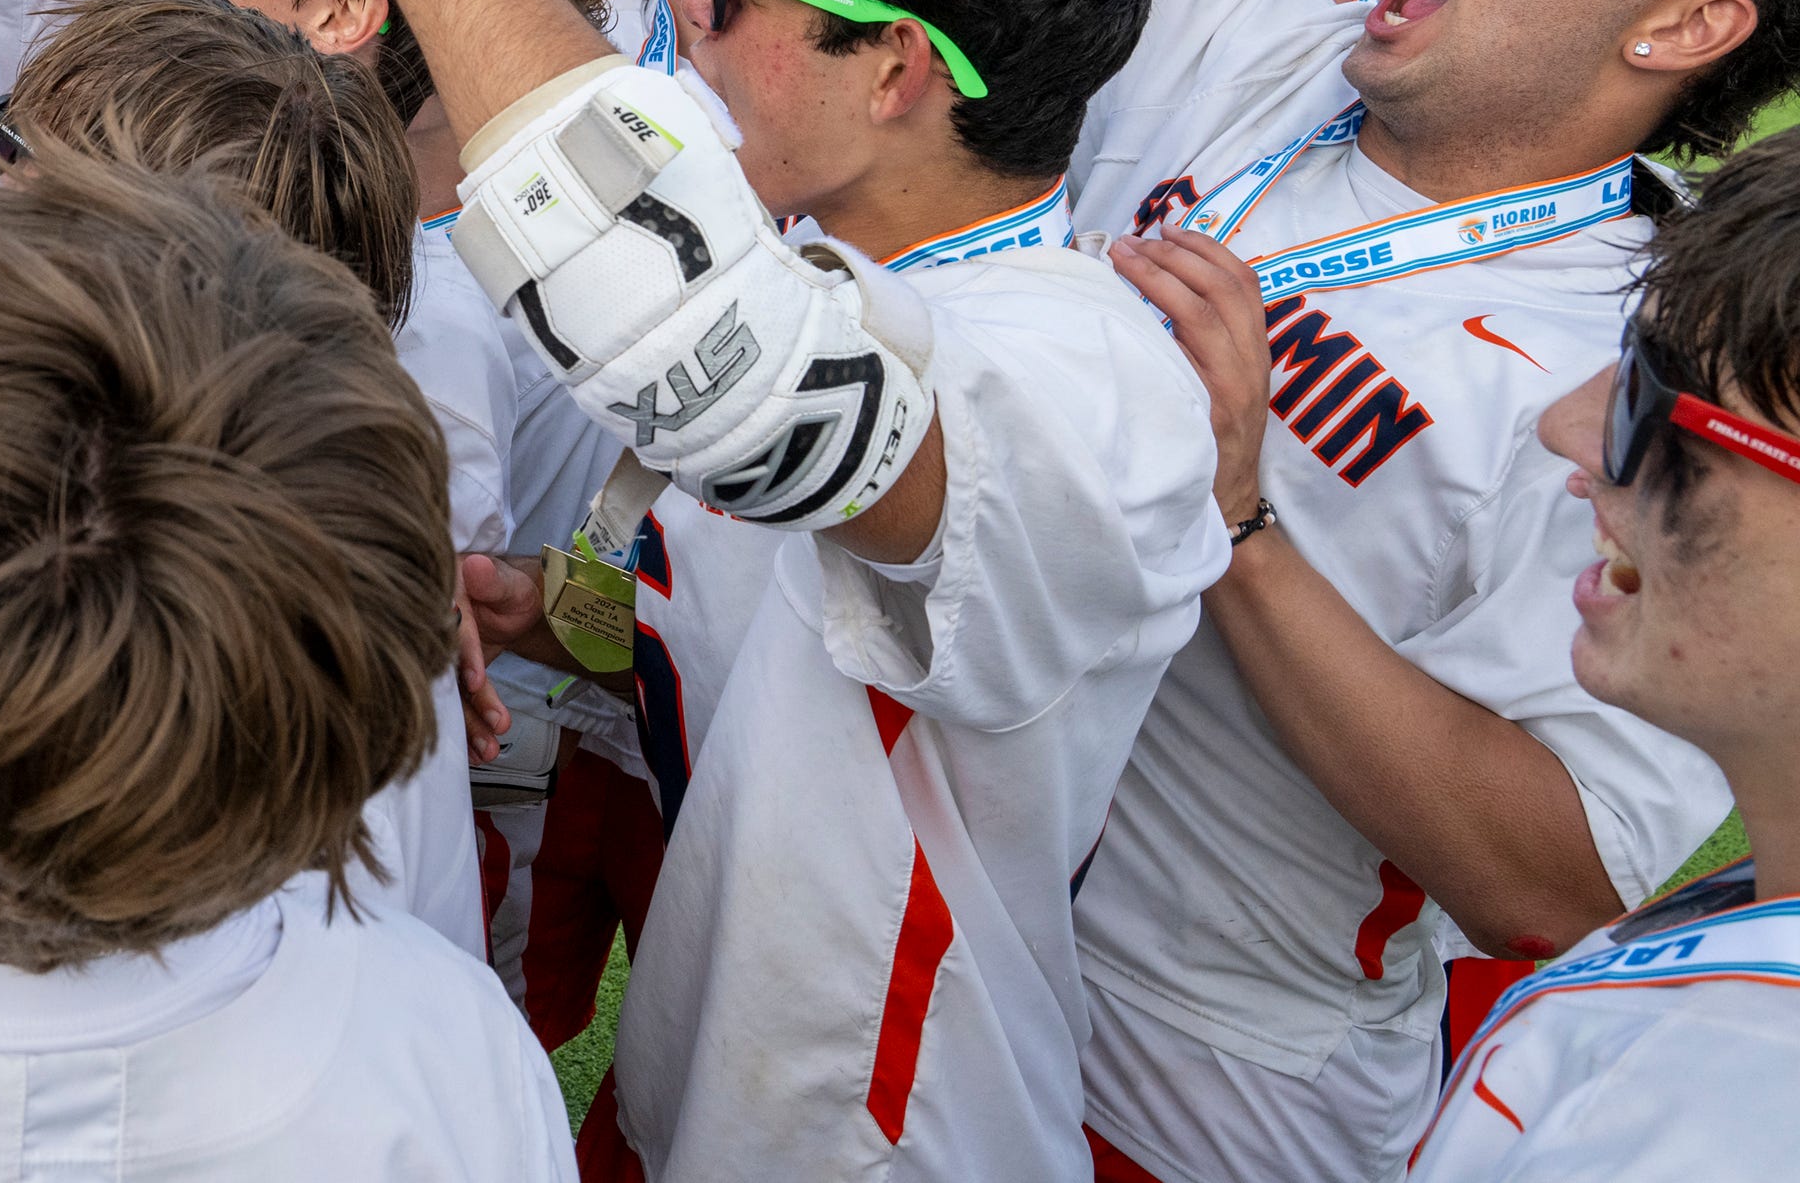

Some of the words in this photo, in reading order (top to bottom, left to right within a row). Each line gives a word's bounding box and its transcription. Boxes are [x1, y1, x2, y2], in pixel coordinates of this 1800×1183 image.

[613, 106, 660, 143] 360+
[513, 187, 532, 204] LOCK
[522, 182, 553, 217] 360+
[1492, 201, 1557, 229] FLORIDA
[606, 298, 762, 447] STX
[1706, 418, 1749, 446] FHSAA
[1749, 437, 1789, 464] STATE
[583, 602, 605, 617] Class
[608, 612, 619, 622] 1A
[594, 597, 617, 611] 2024
[562, 612, 583, 626] State
[584, 621, 626, 643] Champion
[570, 606, 588, 619] Boys
[590, 614, 625, 634] Lacrosse
